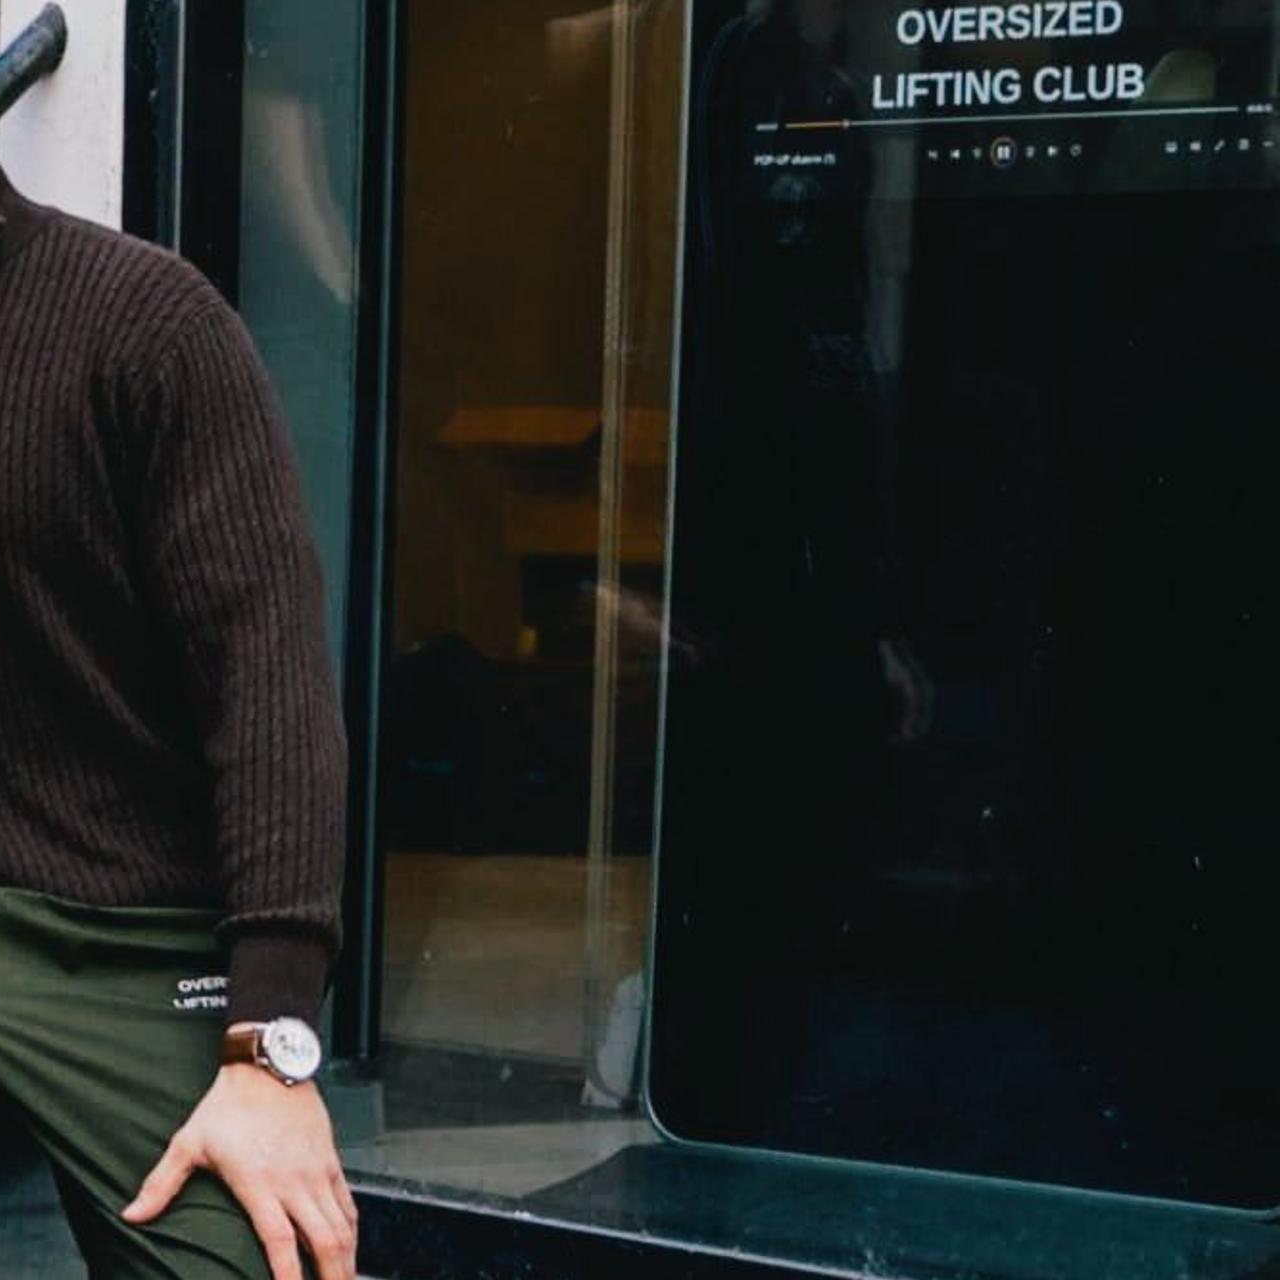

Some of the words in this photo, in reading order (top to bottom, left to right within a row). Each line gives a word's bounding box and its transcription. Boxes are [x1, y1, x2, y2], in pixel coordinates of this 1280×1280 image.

[872, 69, 1023, 111] LIFTING
[1032, 64, 1145, 103] CLUB
[177, 976, 230, 993] OVER
